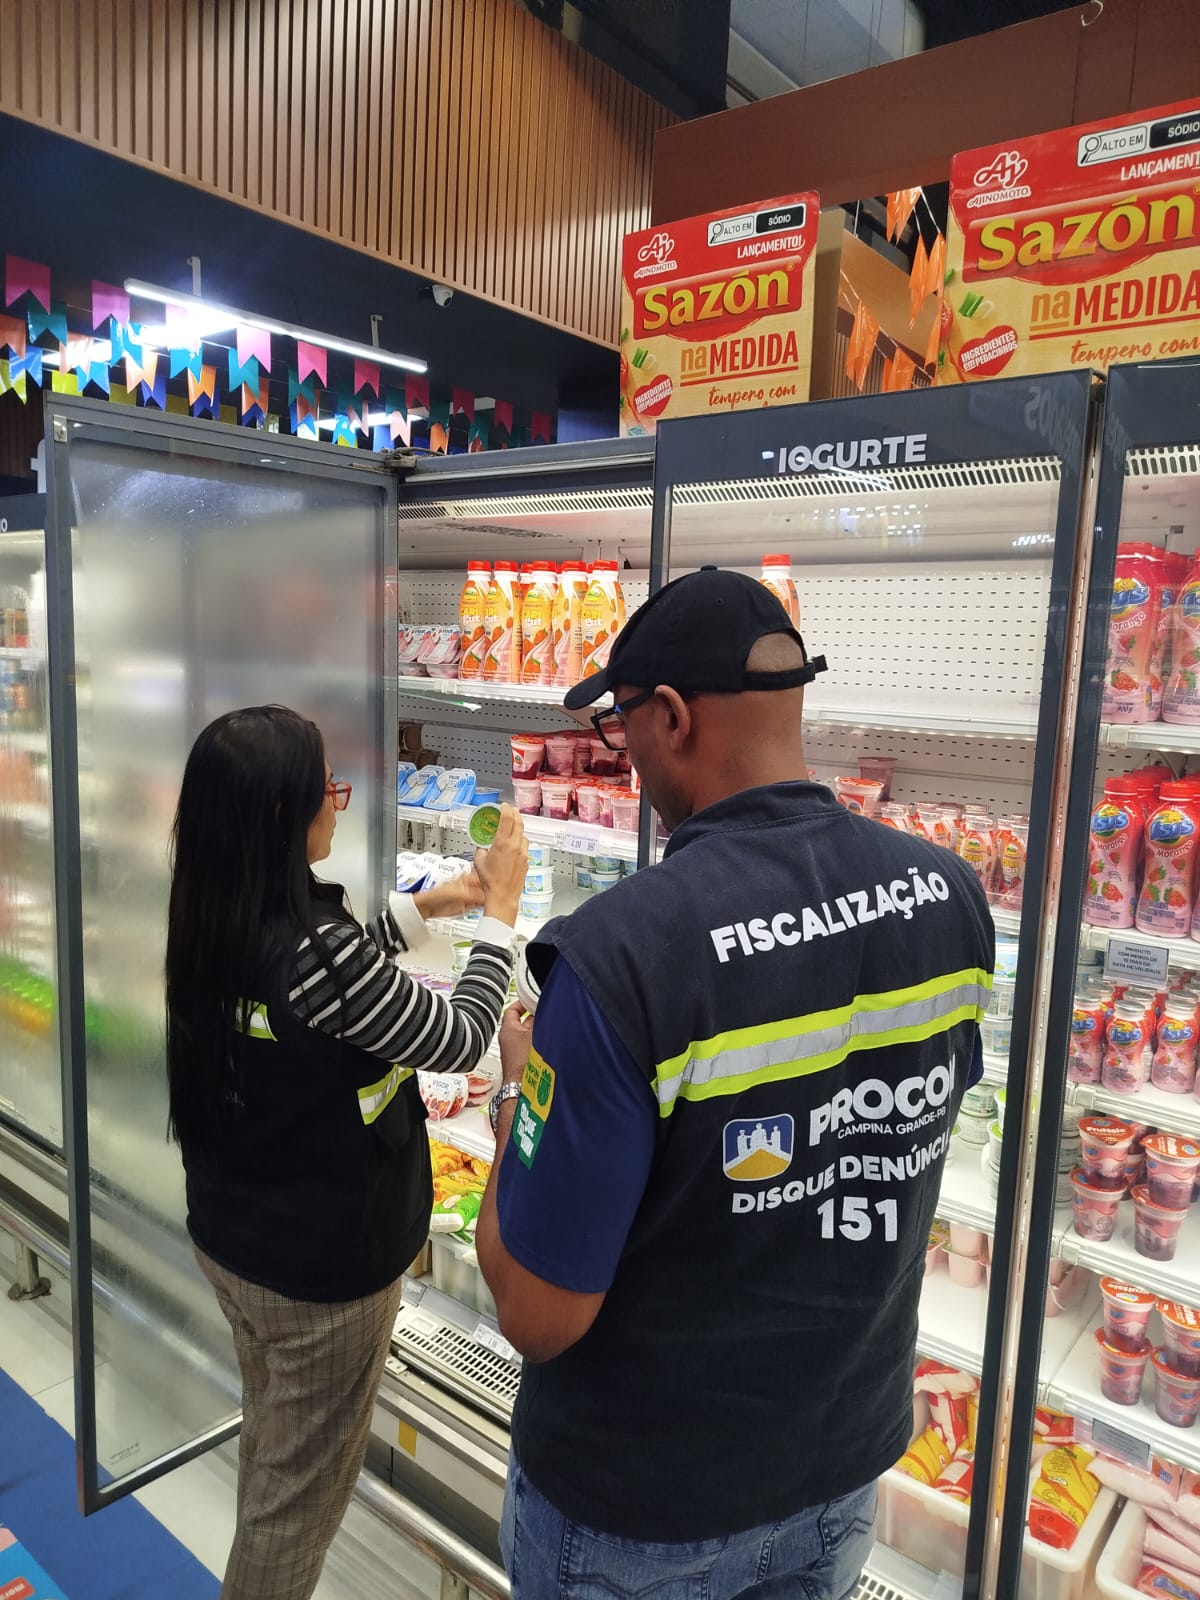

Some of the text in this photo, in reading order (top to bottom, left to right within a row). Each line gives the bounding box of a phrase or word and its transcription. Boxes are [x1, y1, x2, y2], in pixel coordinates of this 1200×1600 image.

[1101, 133, 1144, 153] ALTO EM
[1168, 121, 1200, 138] SÓDIO
[724, 222, 752, 236] ALTO EM
[768, 213, 791, 226] SÓDIO
[977, 193, 1196, 271] Sazón
[737, 235, 804, 258] LANÇAMENTO!
[643, 270, 790, 330] Sazón
[709, 330, 799, 375] MEDIDA
[961, 330, 1016, 364] INGREDIENTES
[975, 340, 1017, 367] PEDACINHOS
[1070, 337, 1200, 368] tempero com
[709, 384, 797, 410] tempero com
[778, 433, 928, 473] IOGURTE
[1112, 611, 1145, 632] orango
[1097, 833, 1128, 851] Morango
[1156, 840, 1193, 858] Morango
[710, 867, 950, 963] FISCALIZAÇÃO
[837, 1106, 946, 1139] CAMPINA GRANDE-PB
[732, 1163, 835, 1214] DISQUE
[817, 1196, 898, 1242] 151
